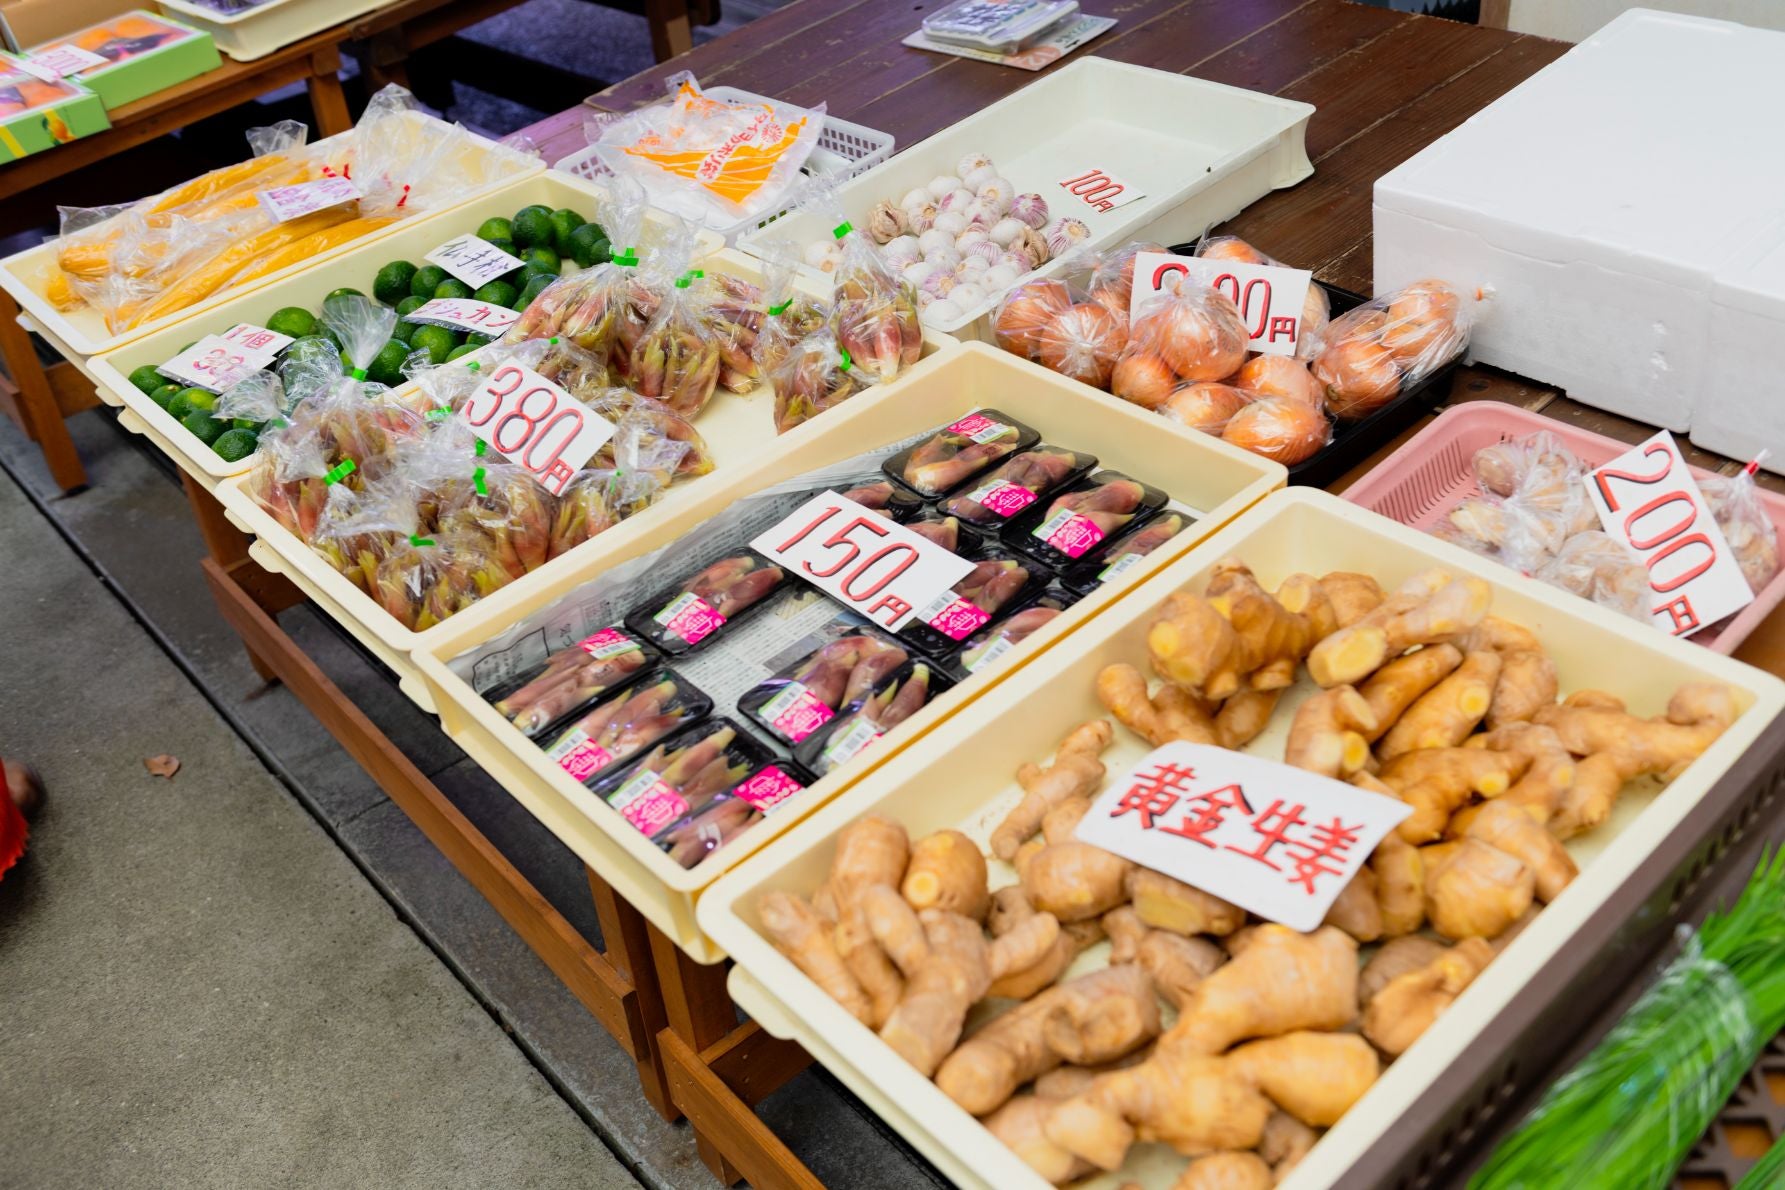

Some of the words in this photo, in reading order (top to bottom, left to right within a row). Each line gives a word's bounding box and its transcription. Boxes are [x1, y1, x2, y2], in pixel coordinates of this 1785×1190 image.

[1059, 169, 1125, 213] 100円
[466, 366, 584, 496] 380円
[776, 505, 920, 627] 150円
[1593, 442, 1716, 636] 200円
[1110, 763, 1365, 896] 黄金生姜
